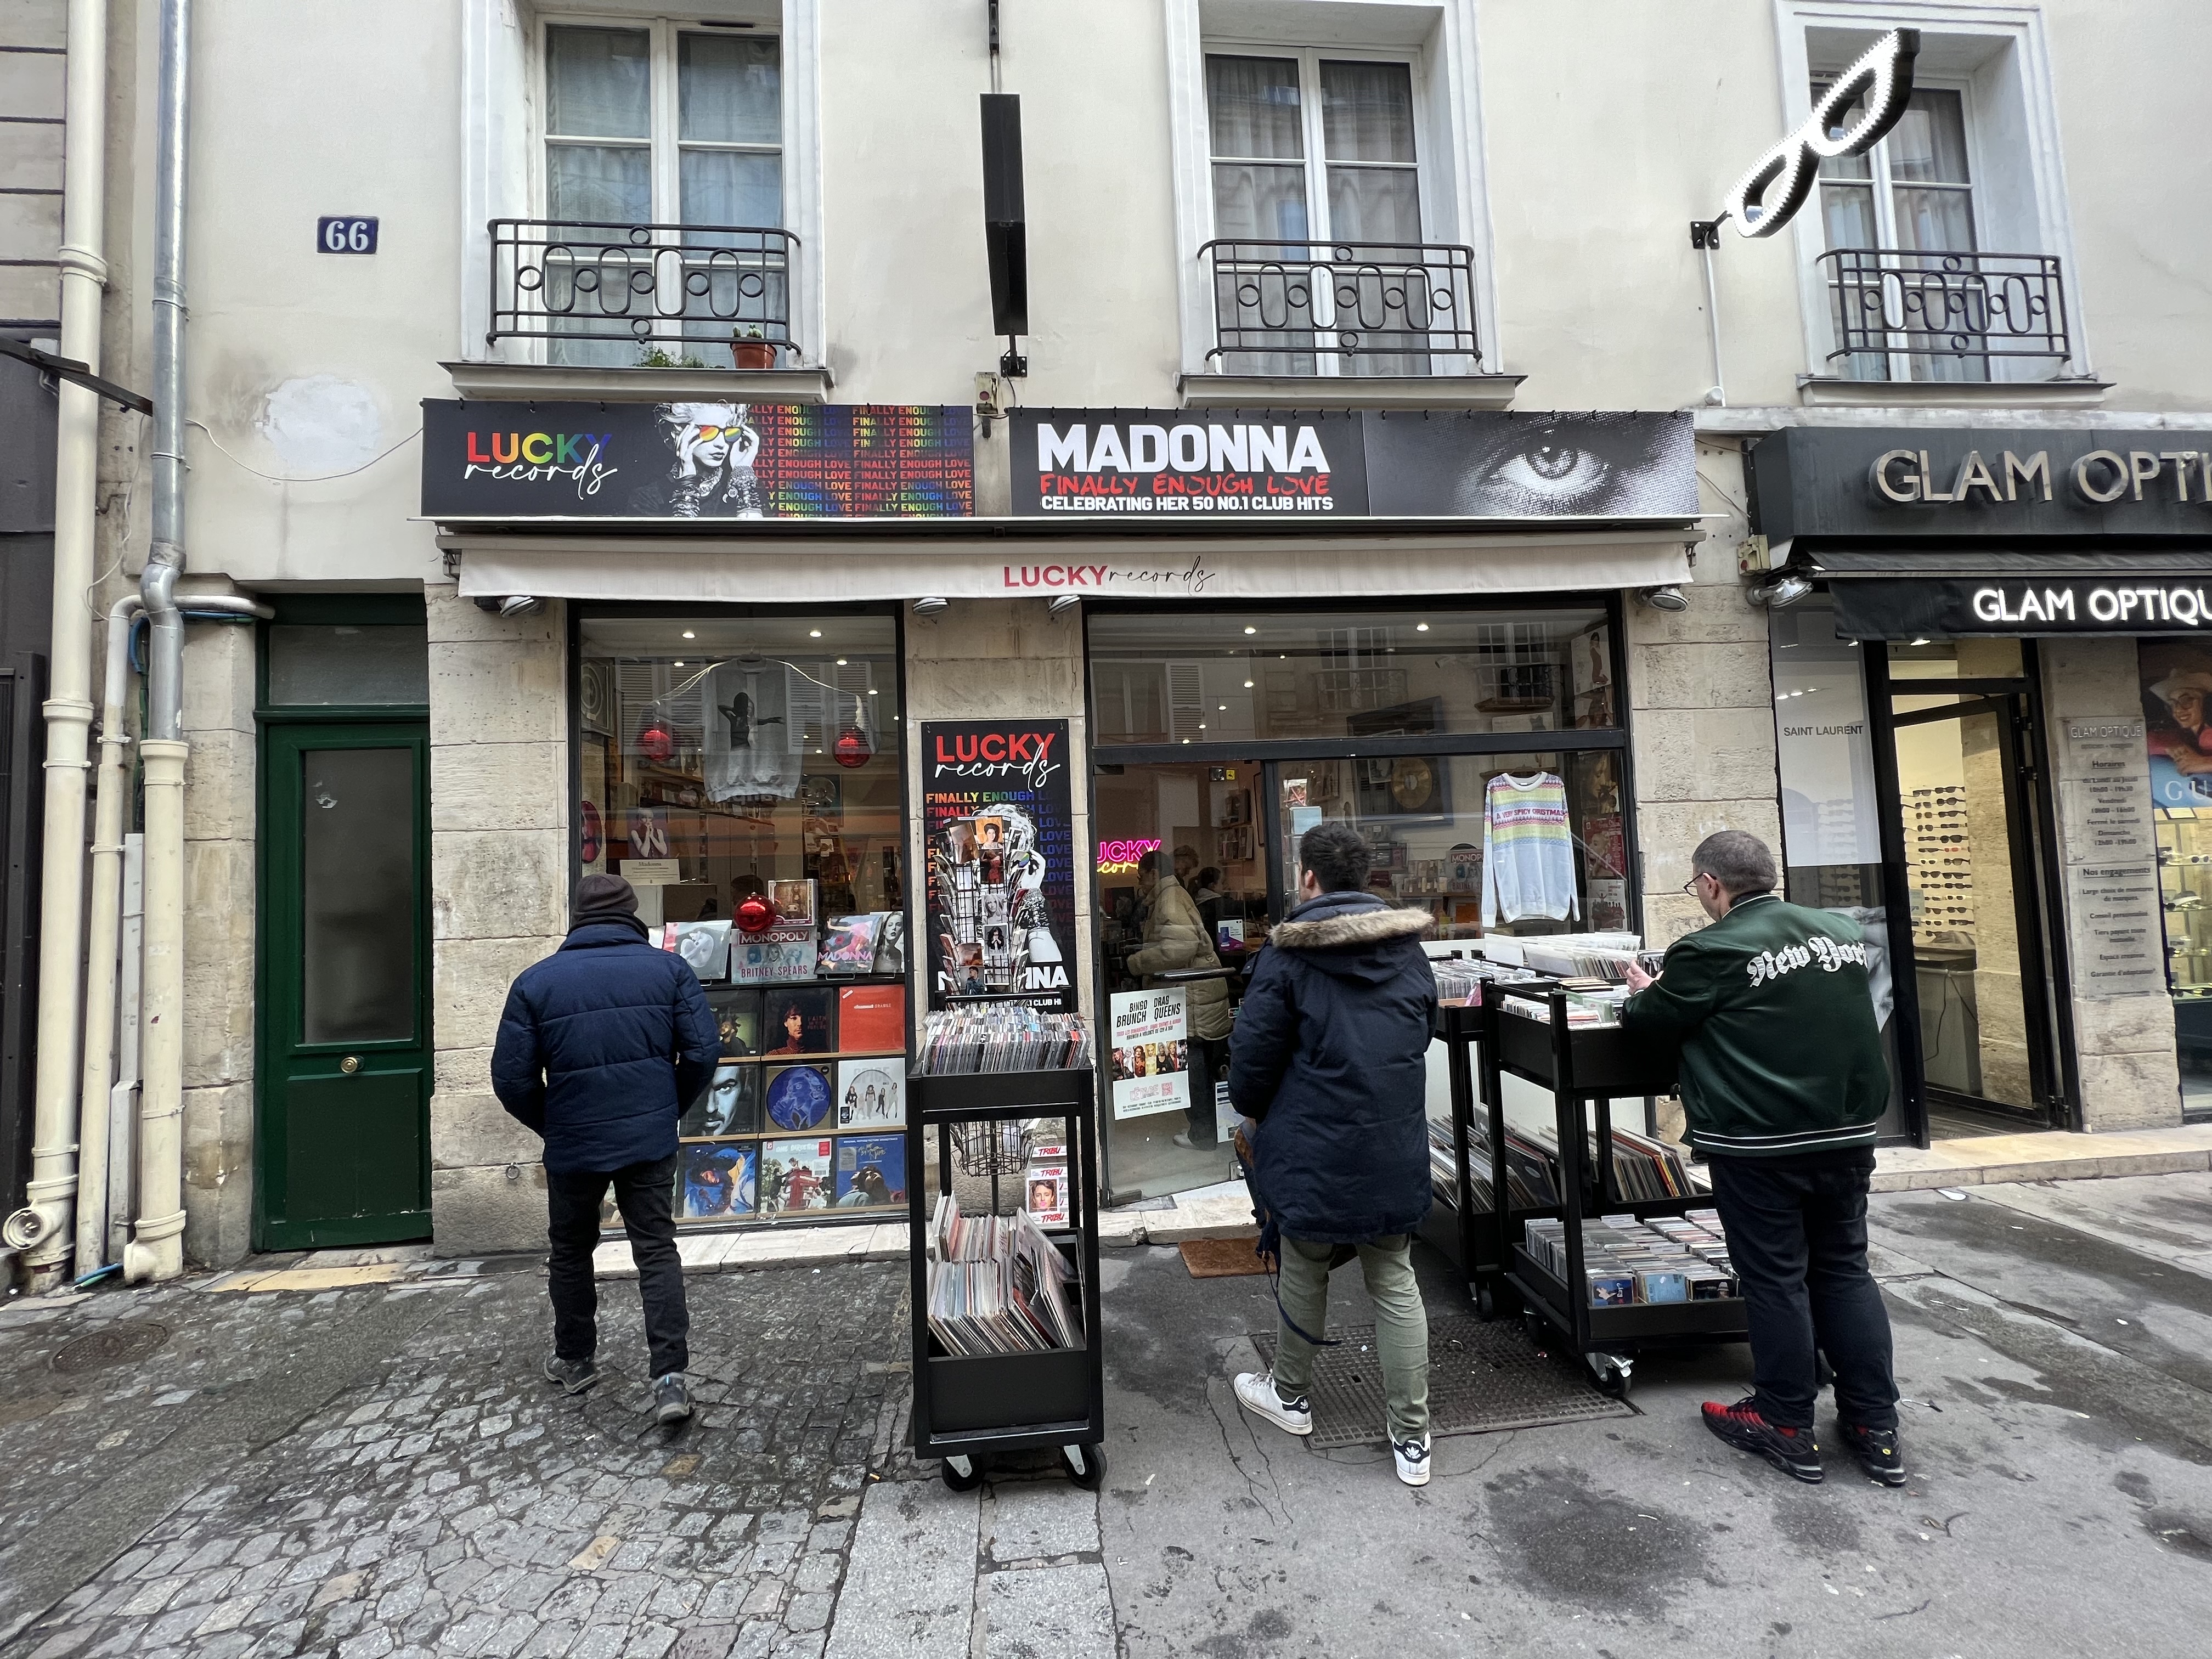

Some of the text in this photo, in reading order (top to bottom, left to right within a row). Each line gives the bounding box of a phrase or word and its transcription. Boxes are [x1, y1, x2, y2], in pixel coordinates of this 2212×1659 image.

[325, 221, 369, 251] 66
[898, 406, 941, 415] ENOU
[777, 416, 821, 425] ENOUG
[853, 417, 895, 426] FINALY
[853, 428, 895, 437] FINALY
[468, 431, 613, 464] LUCKY
[778, 439, 821, 447] ENOUGH
[899, 439, 941, 447] ENOUGH
[1037, 423, 1331, 473] MADONNA
[854, 450, 896, 458] FINALLY
[778, 459, 971, 469] ENOUGH LOVE FINALLY ENOUGH LOVE
[464, 443, 618, 500] records
[778, 470, 971, 479] ENOUGH LOVE FINALLY ENOUGH LOVE
[1870, 449, 2212, 503] GLAM OPTI
[778, 480, 972, 490] ENOUGH LOVE FINALLY ENOUGH LOVE
[1040, 473, 1330, 496] FINALLY ENOUGH LOVE
[778, 490, 972, 501] ENOUGH LOVE FINALLY ENOUGH LOVE
[778, 501, 973, 512] ENOUGH LOVE FINALLY ENOUGH LOVE
[1042, 495, 1334, 511] CELEBRATING HER 50 NO.1 CLUB HITS
[1004, 555, 1215, 596] LUCKY records
[1973, 588, 2075, 621] GLAM
[1784, 725, 1864, 736] SAINT LAURENT
[2071, 725, 2142, 738] GLAM OPTIQUE
[936, 733, 1056, 762] LUCKY
[934, 742, 1060, 793] records
[926, 792, 979, 804] FINALLY
[983, 791, 1035, 803] ENOUGH
[927, 805, 979, 817] FINALLY
[1040, 831, 1072, 842] LOVE
[1040, 844, 1072, 855] LOVE
[1046, 858, 1073, 868] OVE
[1452, 853, 1483, 863] MONOP
[741, 932, 808, 944] MONOPOLY
[817, 951, 873, 961] MADONNA
[1747, 935, 1868, 987] New Yor
[741, 964, 808, 978] BRITNEY SPEARS
[1129, 1000, 1148, 1013] BINGO
[1154, 995, 1170, 1008] DRAG
[1154, 1003, 1181, 1022] QUEENS
[1116, 1011, 1147, 1028] BRUNCH
[1039, 1146, 1061, 1156] TRIBU
[1040, 1168, 1063, 1177] TRIBU
[1041, 1212, 1065, 1223] TRIBU
